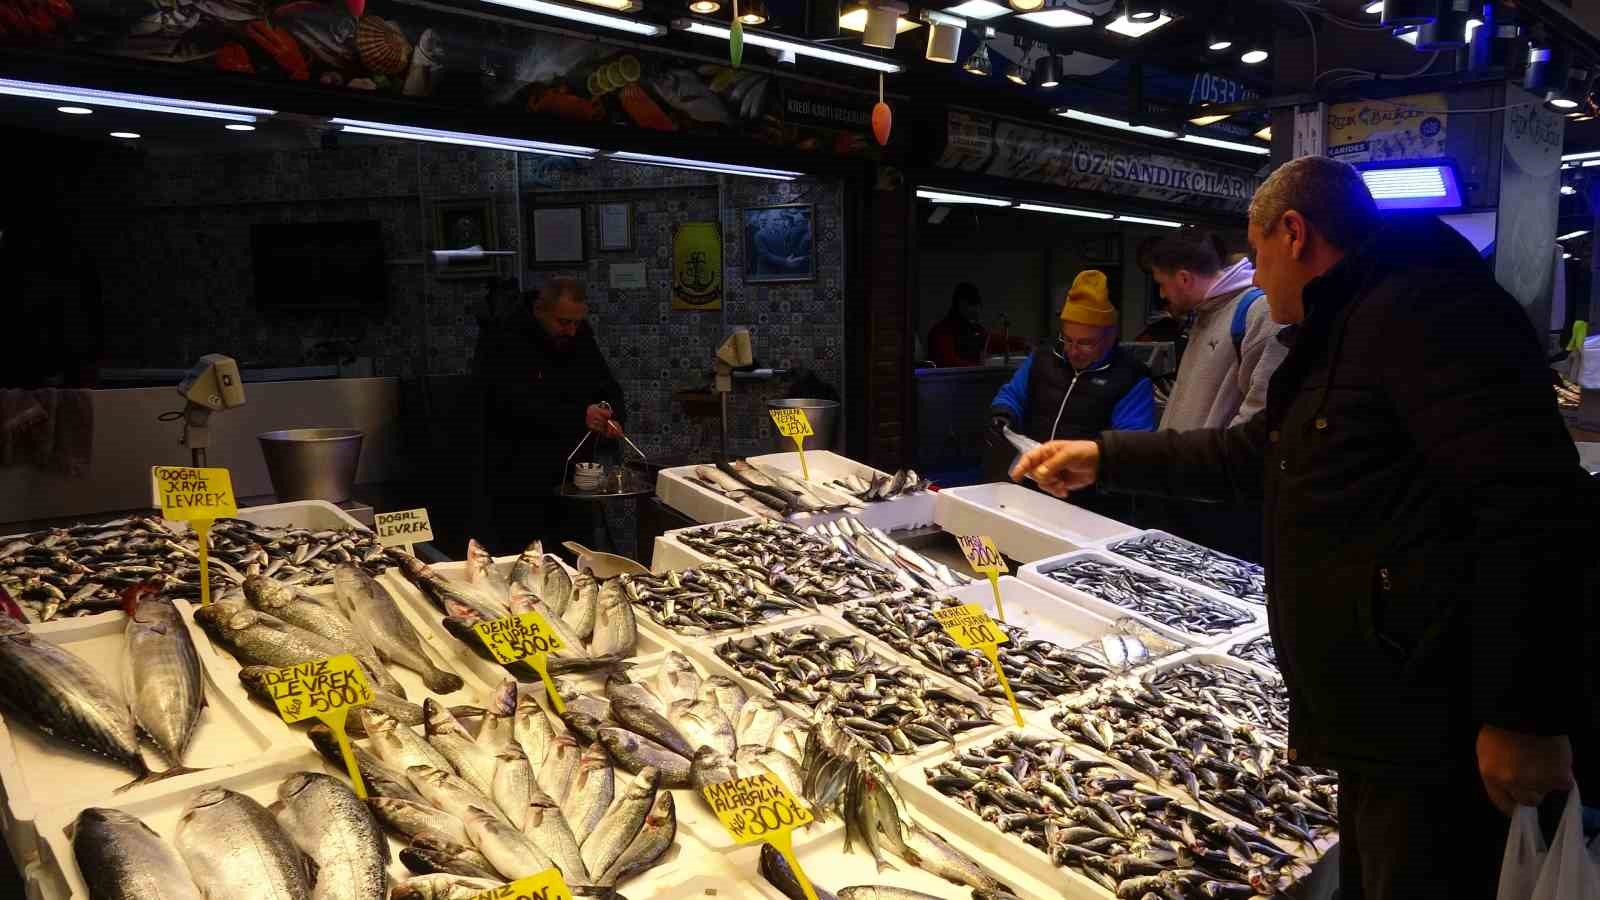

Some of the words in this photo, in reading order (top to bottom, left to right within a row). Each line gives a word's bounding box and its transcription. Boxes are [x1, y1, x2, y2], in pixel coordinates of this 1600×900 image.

[1074, 144, 1106, 175] ÖZ
[165, 480, 208, 493] KAYA
[166, 491, 230, 508] LEVREK
[379, 520, 429, 537] LEVREK
[961, 624, 996, 645] 100
[273, 669, 360, 700] LEVREK
